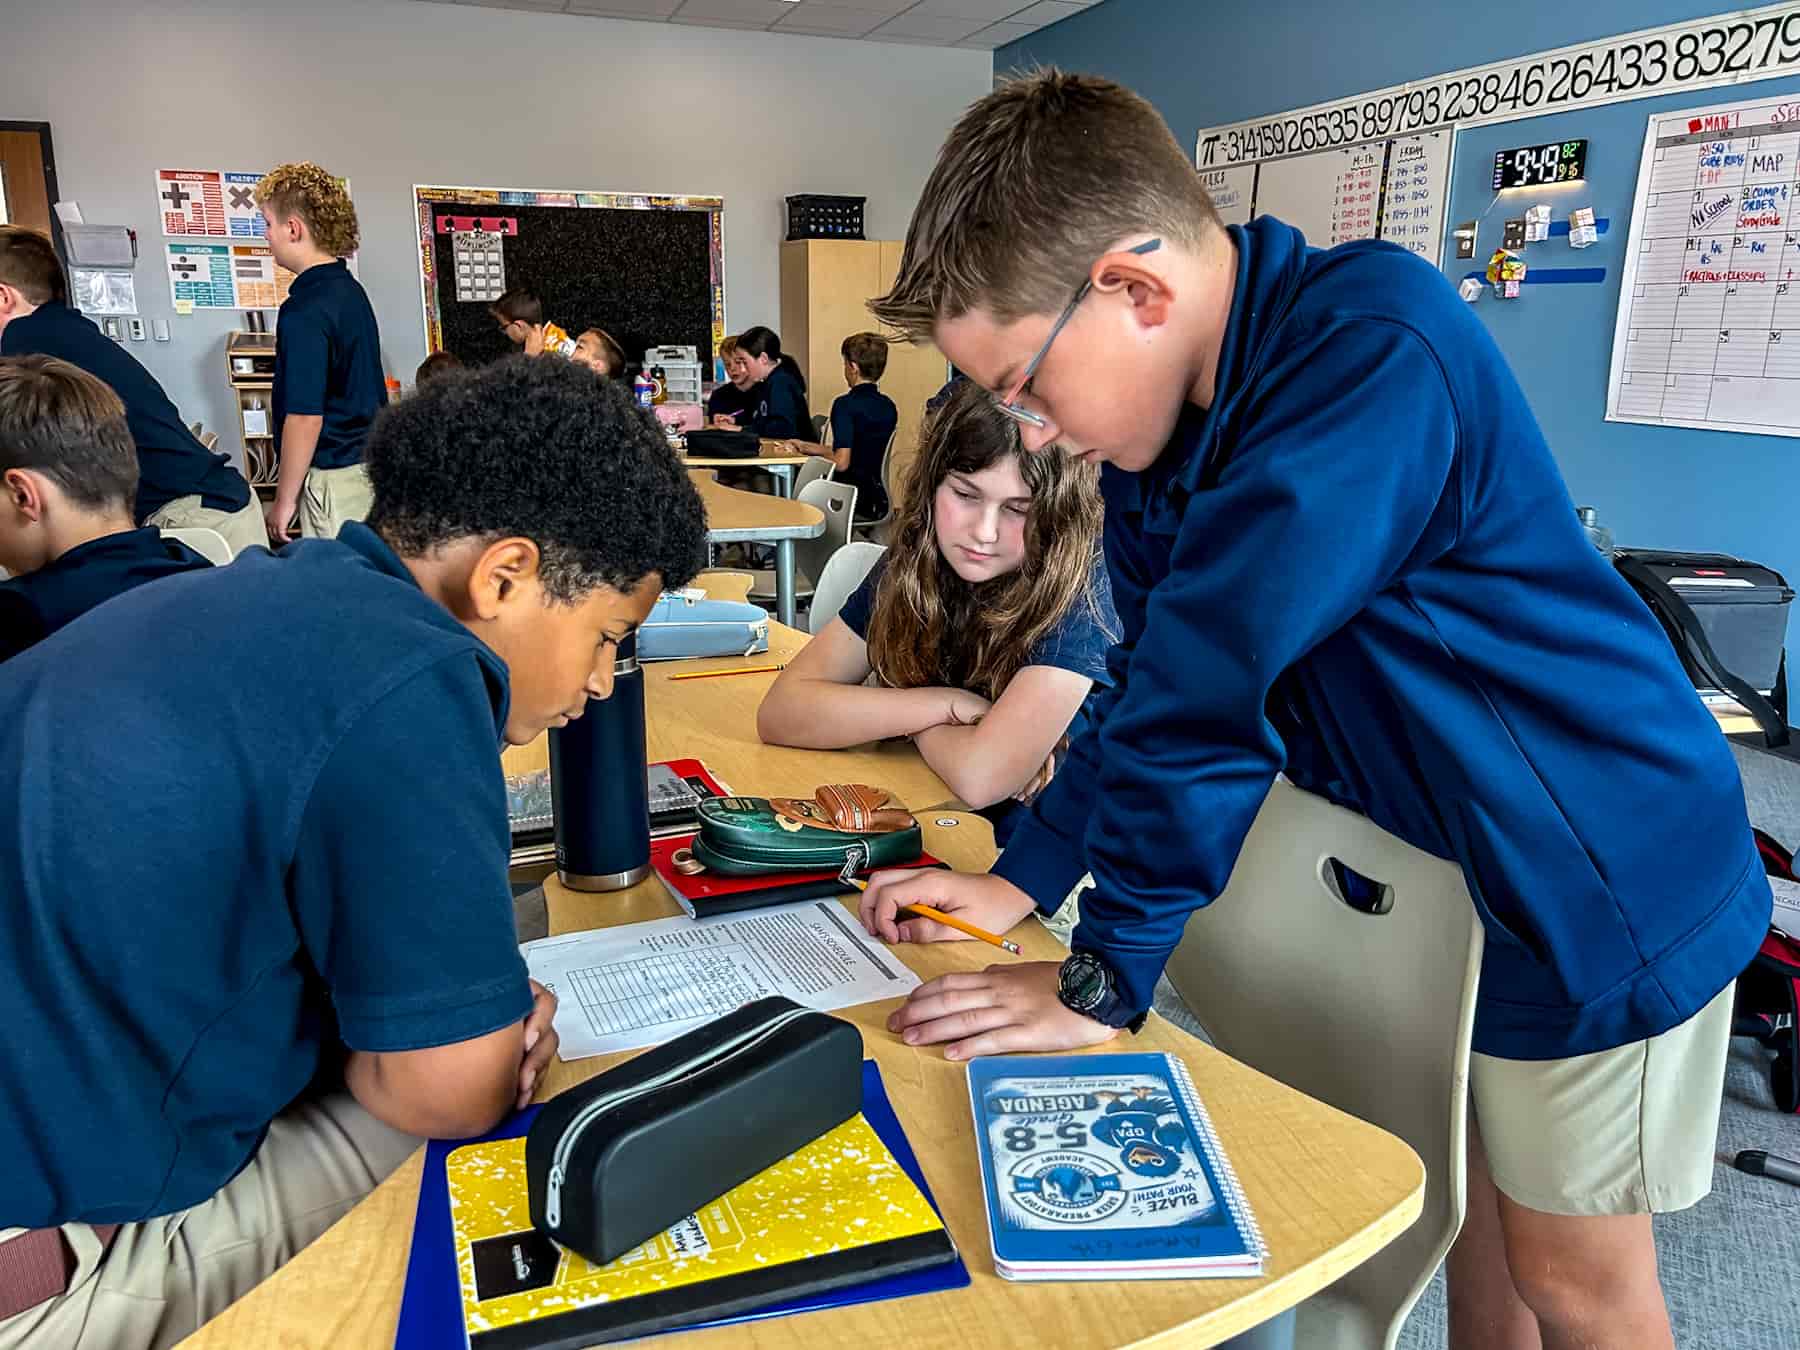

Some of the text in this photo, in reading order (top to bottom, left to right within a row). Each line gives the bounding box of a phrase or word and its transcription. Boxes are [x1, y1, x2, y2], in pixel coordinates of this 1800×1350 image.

[1361, 86, 1441, 139] 89793
[1442, 64, 1546, 122] 23846
[1547, 39, 1668, 104] 26433
[1751, 152, 1784, 174] MAP
[1751, 186, 1779, 199] COMP
[1000, 1095, 1086, 1113] AGENDA
[1015, 1112, 1075, 1128] Grade
[1003, 1122, 1088, 1152] 5-8
[1115, 1127, 1145, 1138] GPA
[1167, 1183, 1197, 1194] YOUR
[1148, 1192, 1199, 1213] BLAZE
